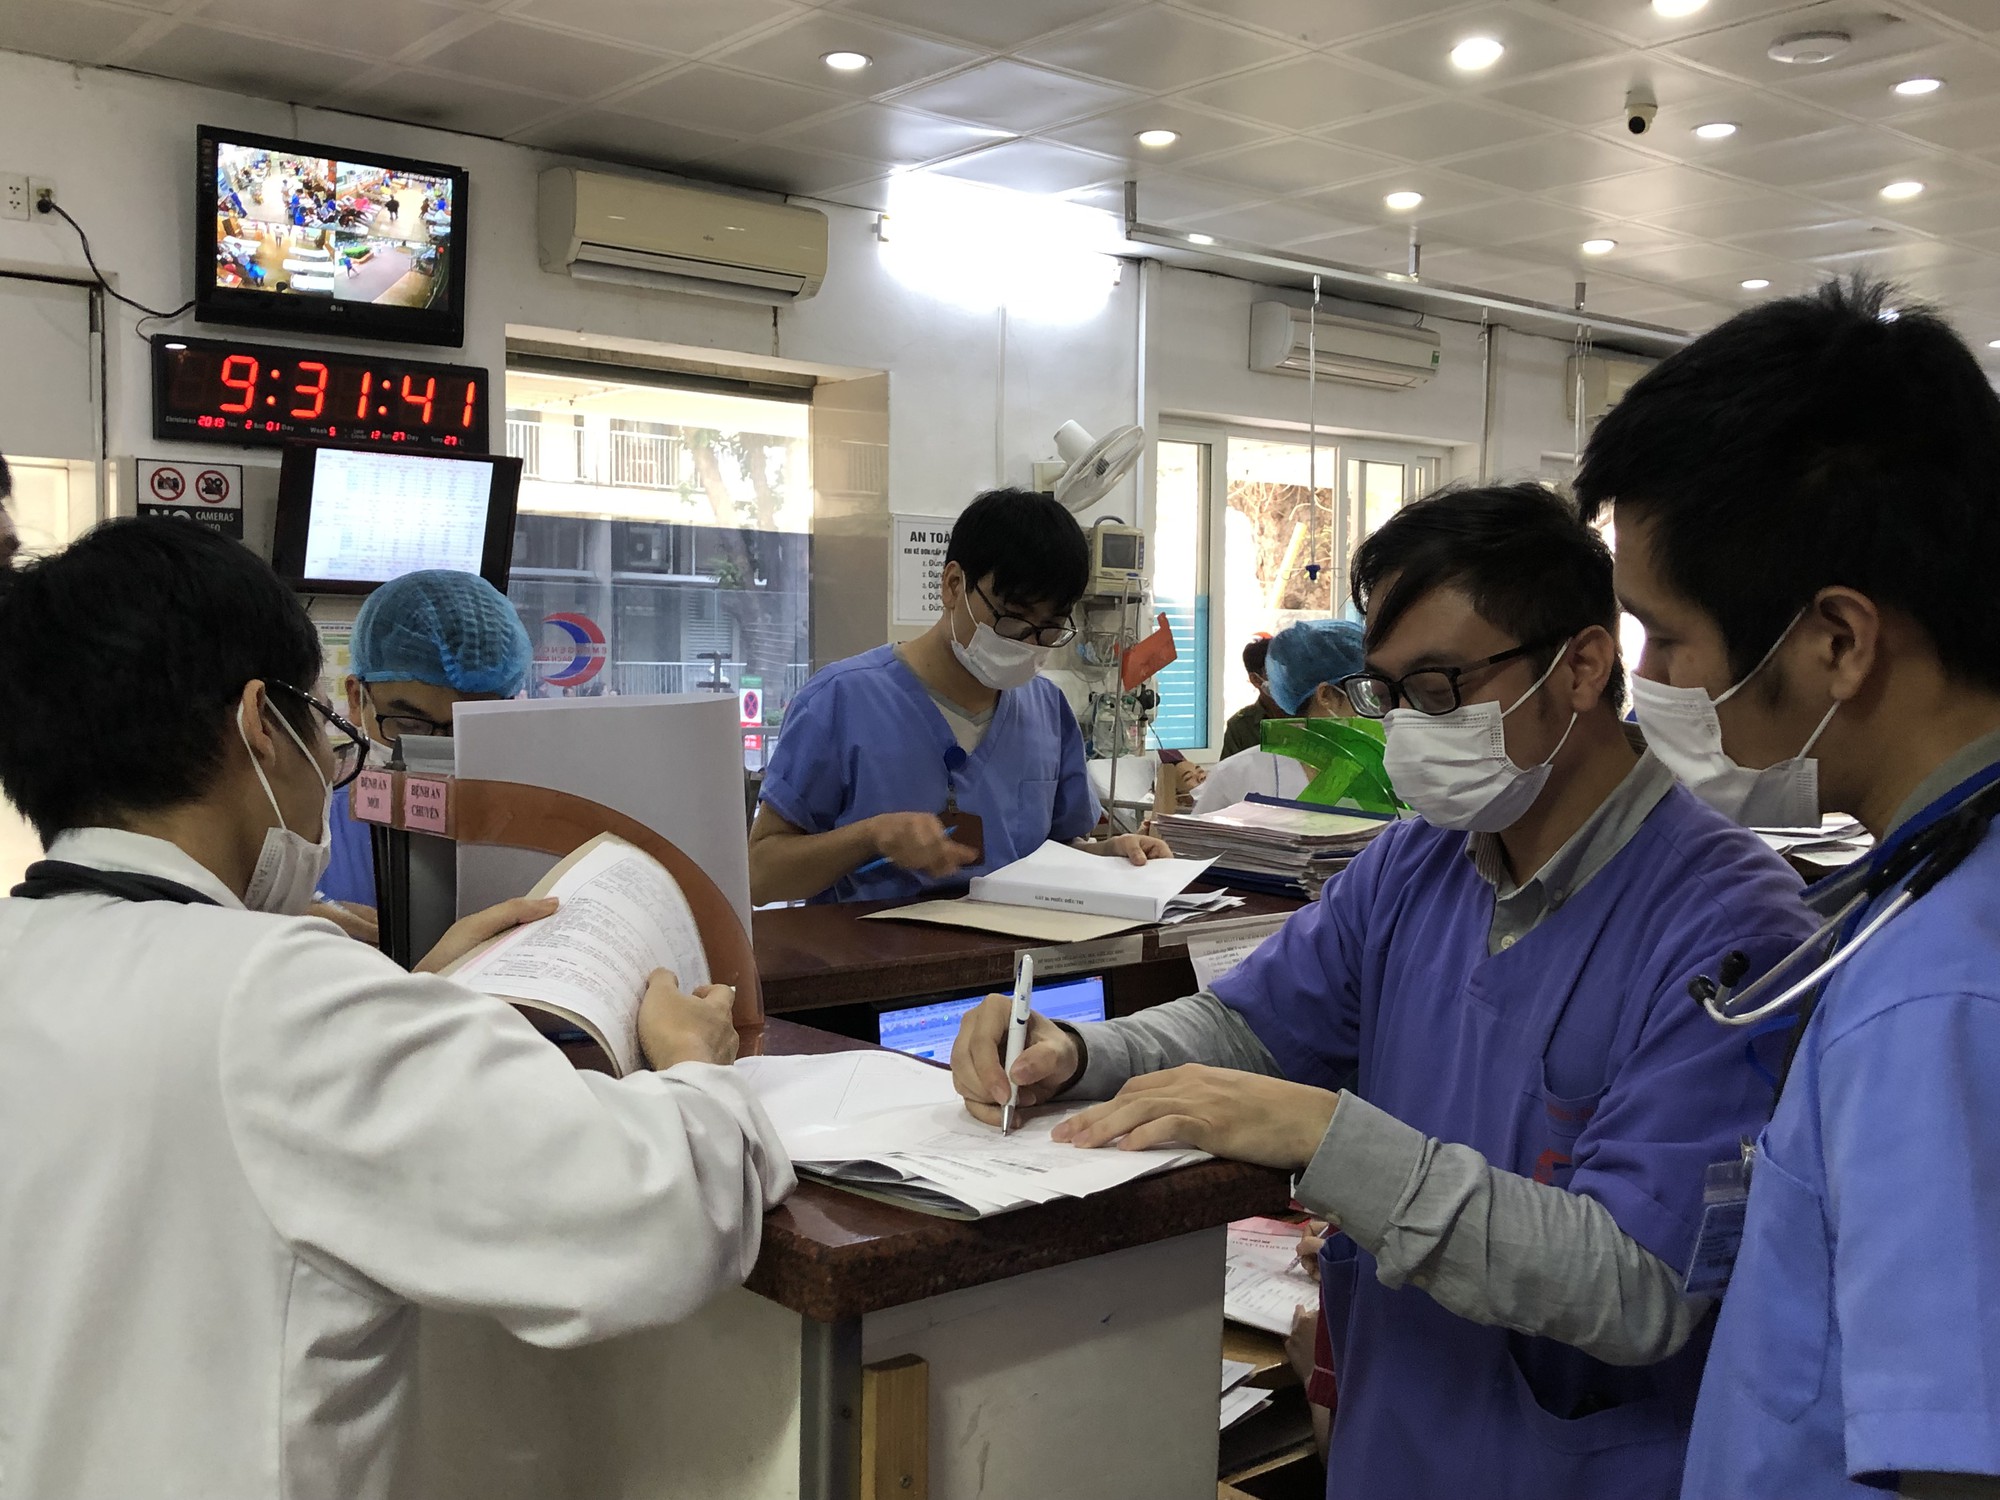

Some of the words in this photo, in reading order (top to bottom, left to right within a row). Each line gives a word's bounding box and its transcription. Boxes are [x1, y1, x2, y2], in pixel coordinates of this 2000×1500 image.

[219, 354, 476, 429] 9:31:41
[265, 420, 281, 432] 01
[281, 424, 295, 432] Day
[310, 427, 327, 435] Week
[407, 434, 419, 442] Day
[195, 511, 234, 522] CAMERAS
[909, 531, 926, 543] AN
[929, 531, 952, 544] TOÀ
[360, 776, 378, 791] BỆNH
[411, 784, 430, 799] BỆNH
